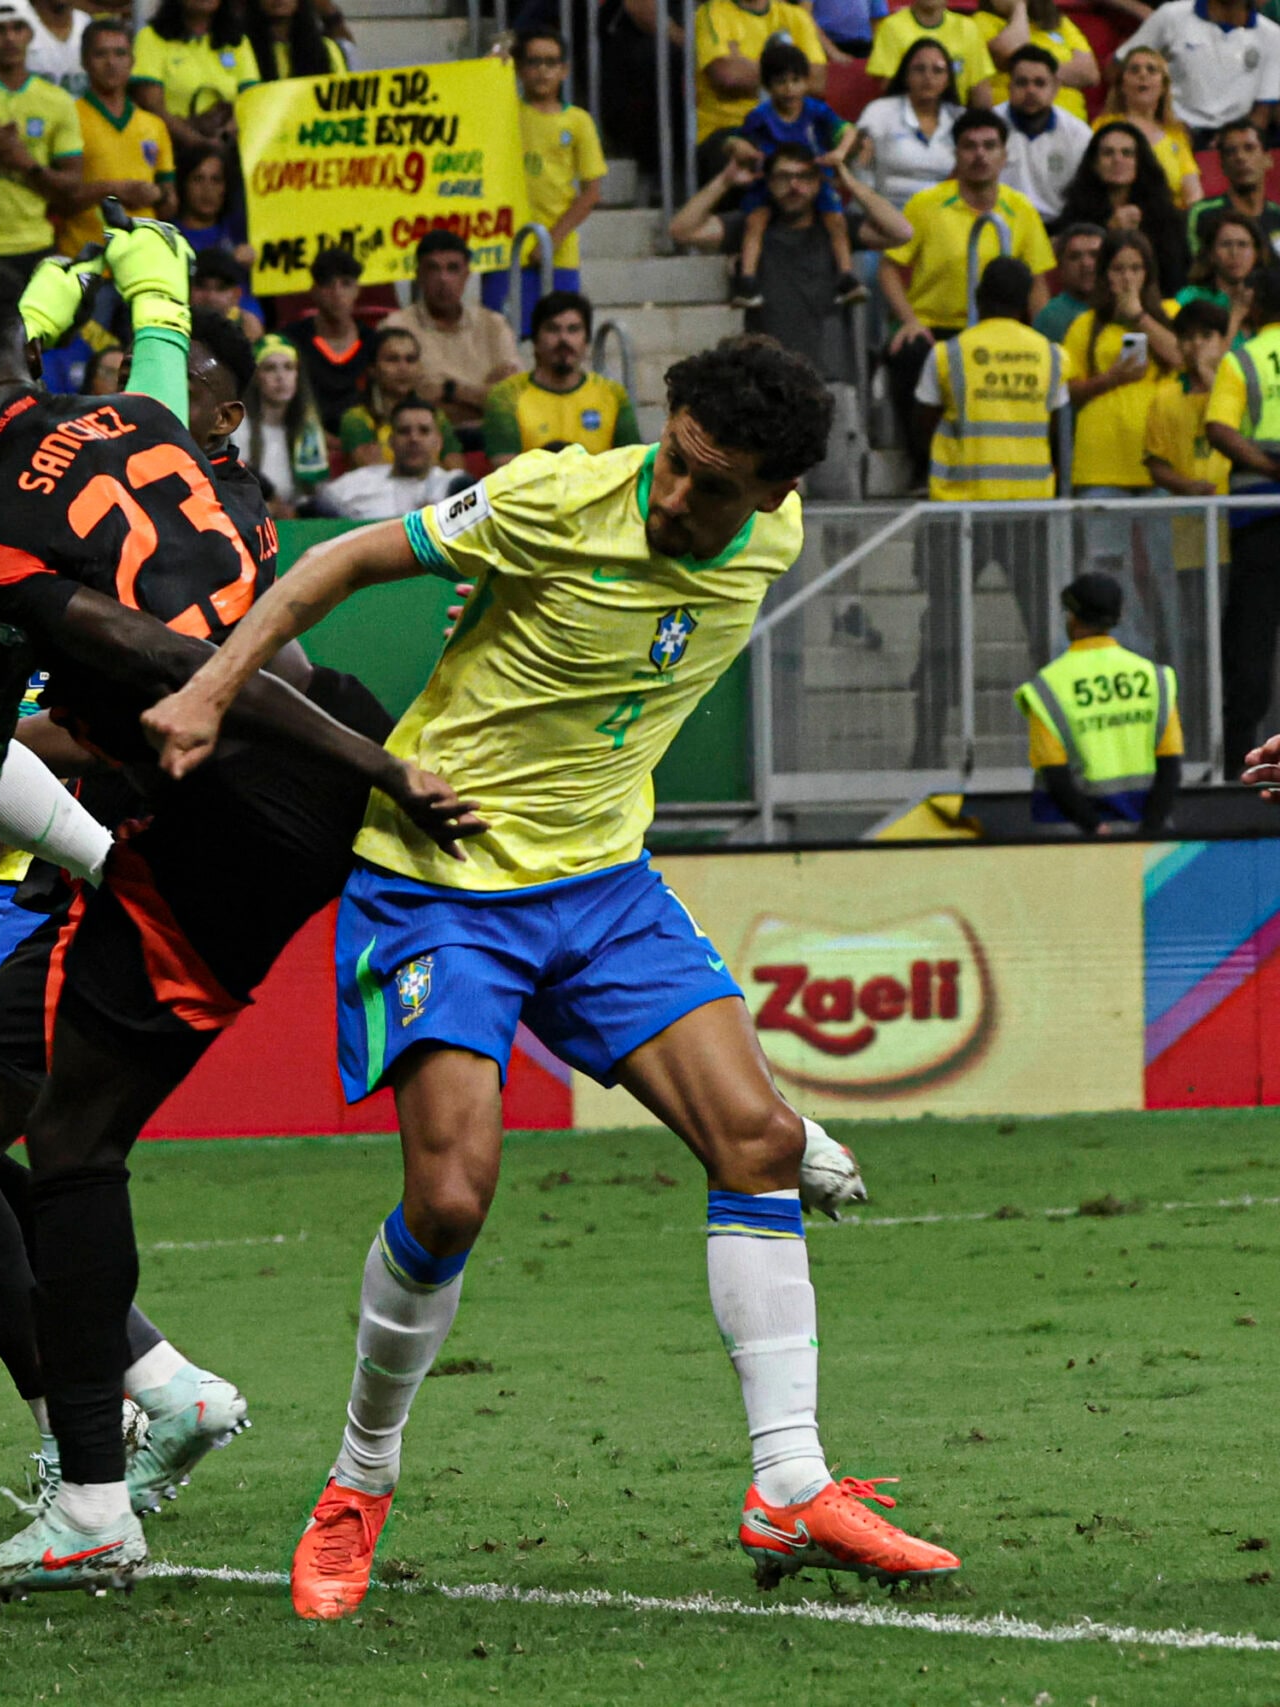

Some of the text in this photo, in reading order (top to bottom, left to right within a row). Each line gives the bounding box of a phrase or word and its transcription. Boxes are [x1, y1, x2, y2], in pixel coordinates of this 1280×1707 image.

[314, 70, 439, 111] VINI JR.
[298, 114, 458, 147] HOJE ESTOU
[395, 151, 426, 195] 9
[259, 236, 308, 275] ME
[18, 405, 137, 495] SANCHEZ
[67, 443, 258, 640] 23
[1073, 670, 1152, 707] 5362
[752, 959, 960, 1056] Zaeli
